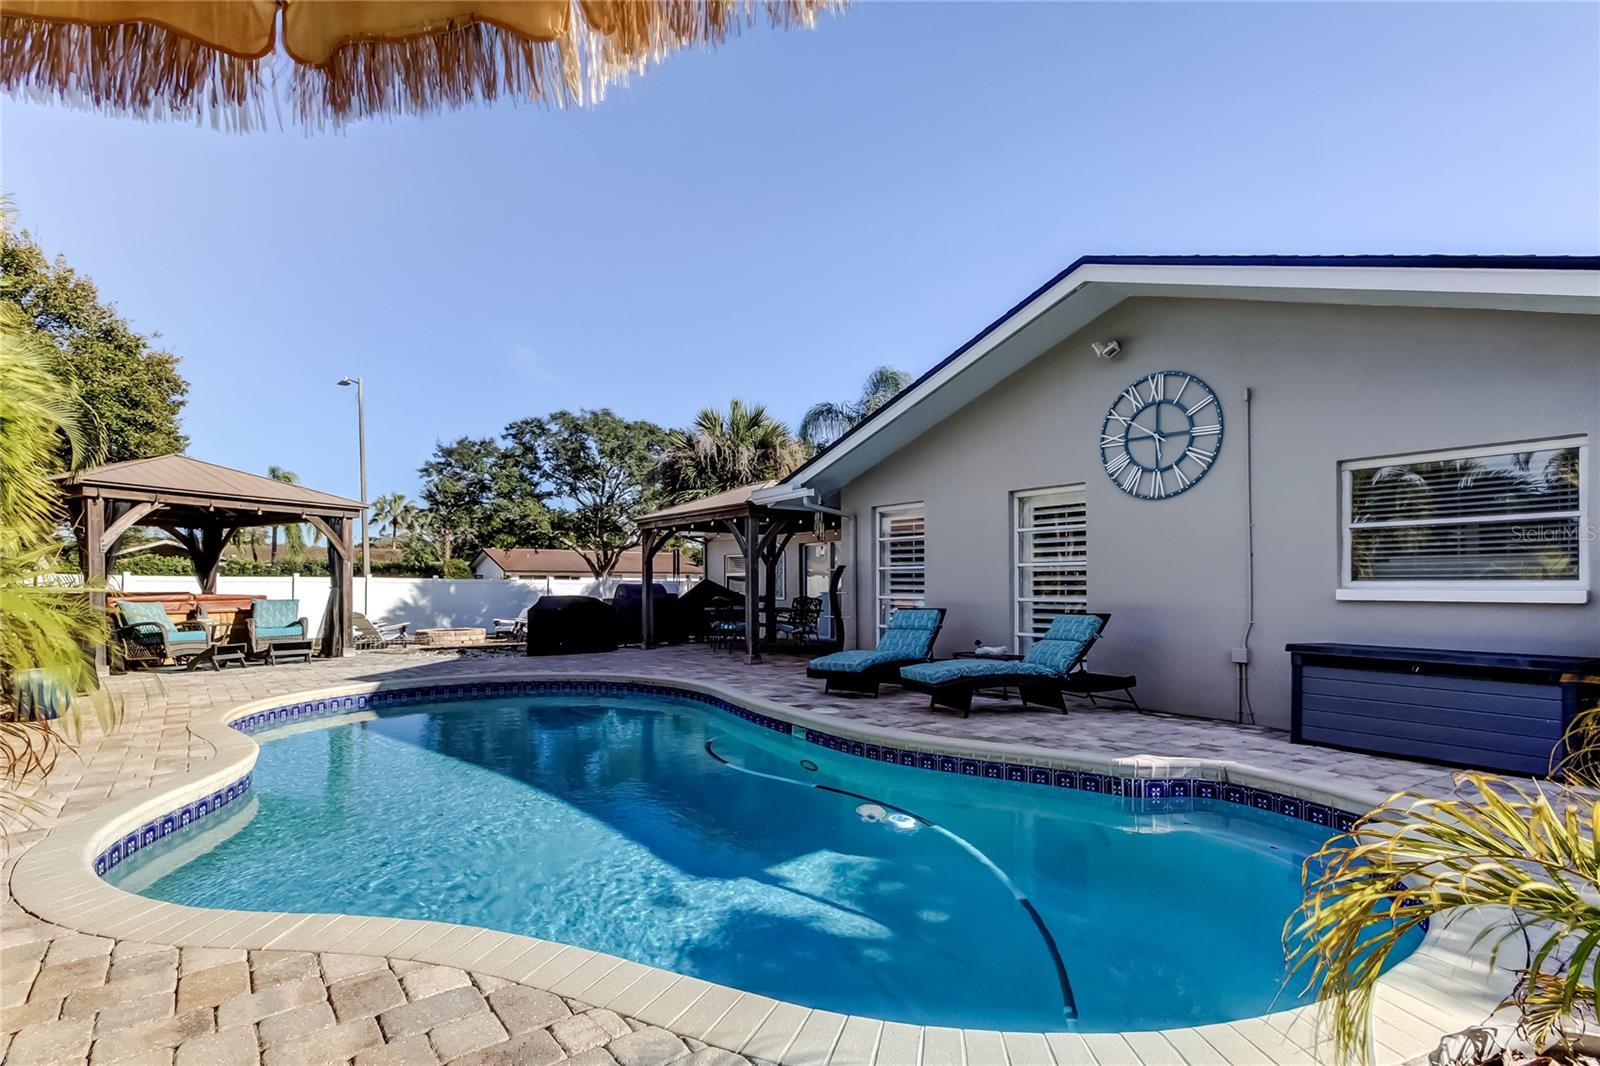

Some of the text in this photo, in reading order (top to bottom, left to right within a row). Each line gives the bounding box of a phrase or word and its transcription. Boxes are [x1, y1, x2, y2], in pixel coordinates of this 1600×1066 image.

[1122, 386, 1144, 412] XI
[1148, 373, 1164, 402] XII
[1107, 409, 1131, 427] X
[1186, 394, 1214, 417] II
[1101, 433, 1125, 447] IX
[1191, 424, 1222, 436] III
[1105, 451, 1131, 479] VIII
[1173, 463, 1190, 488] V
[1121, 465, 1142, 495] VII
[1150, 469, 1165, 498] VI
